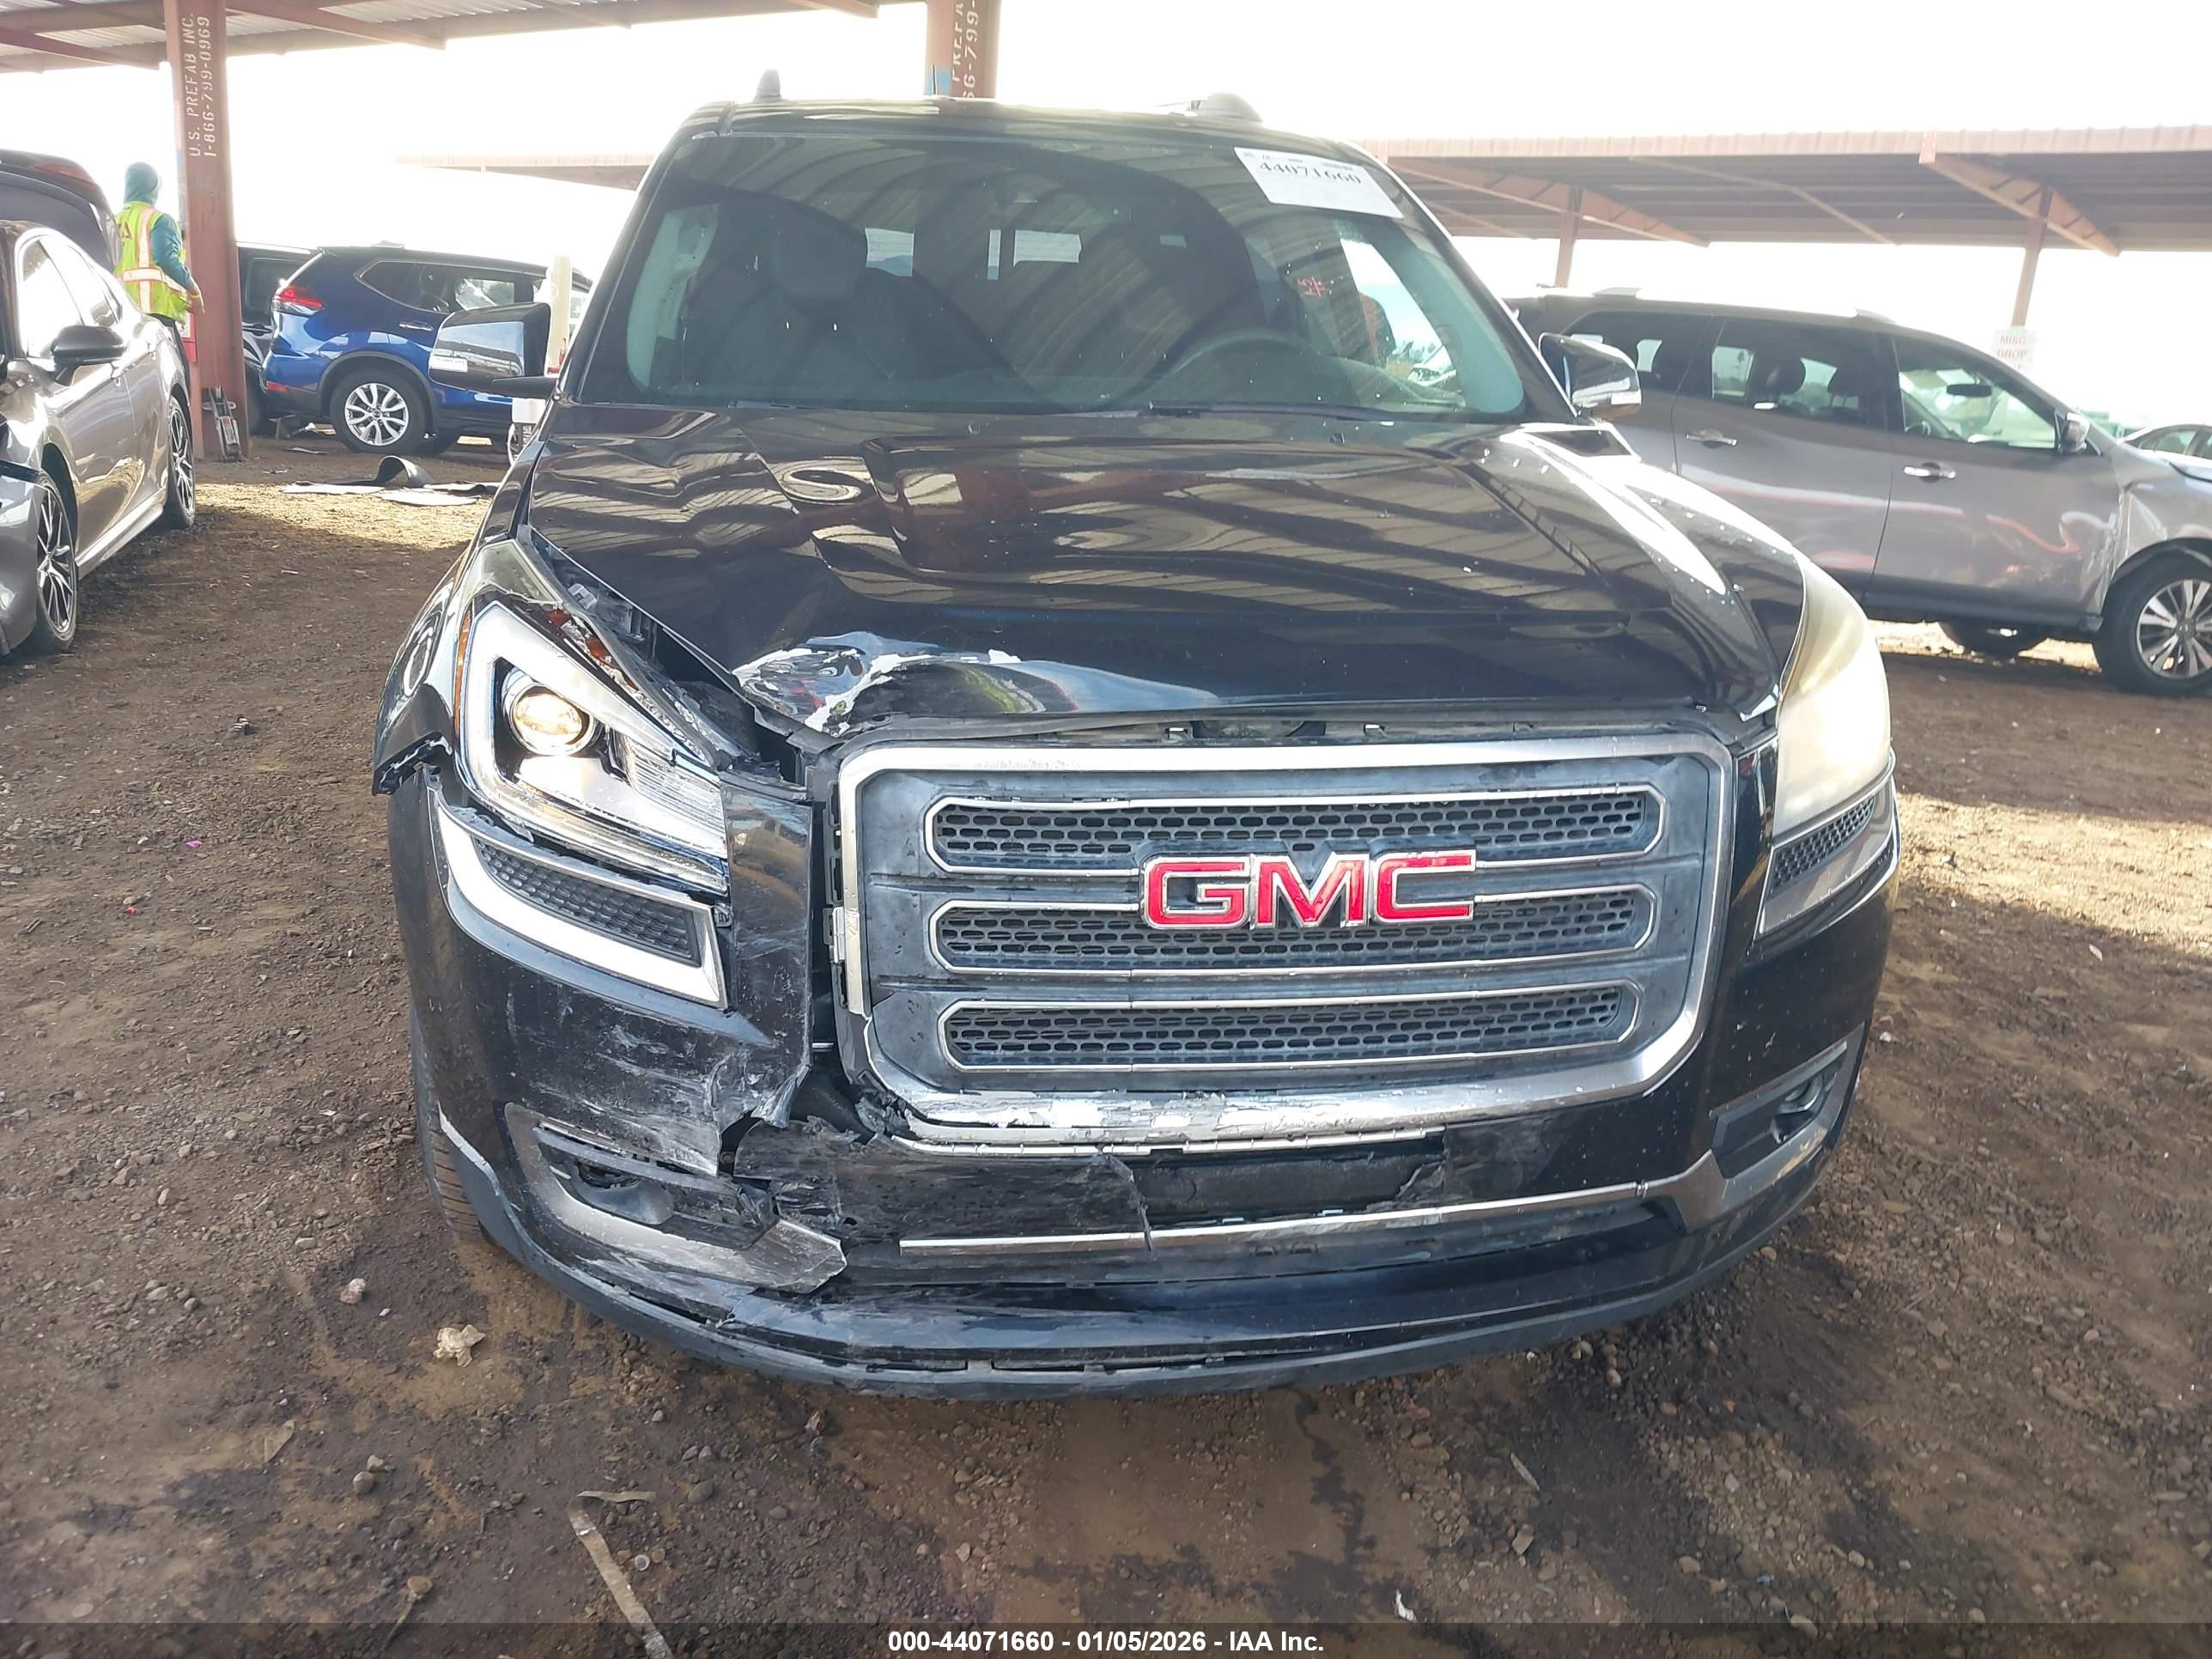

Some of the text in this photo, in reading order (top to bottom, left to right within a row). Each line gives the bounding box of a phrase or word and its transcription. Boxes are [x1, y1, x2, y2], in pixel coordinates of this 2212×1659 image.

[181, 13, 201, 157] U.S. PREFAB INC.
[197, 15, 217, 157] 1-866-799-0969
[1259, 161, 1362, 185] 44071660
[1140, 848, 1477, 931] GMC
